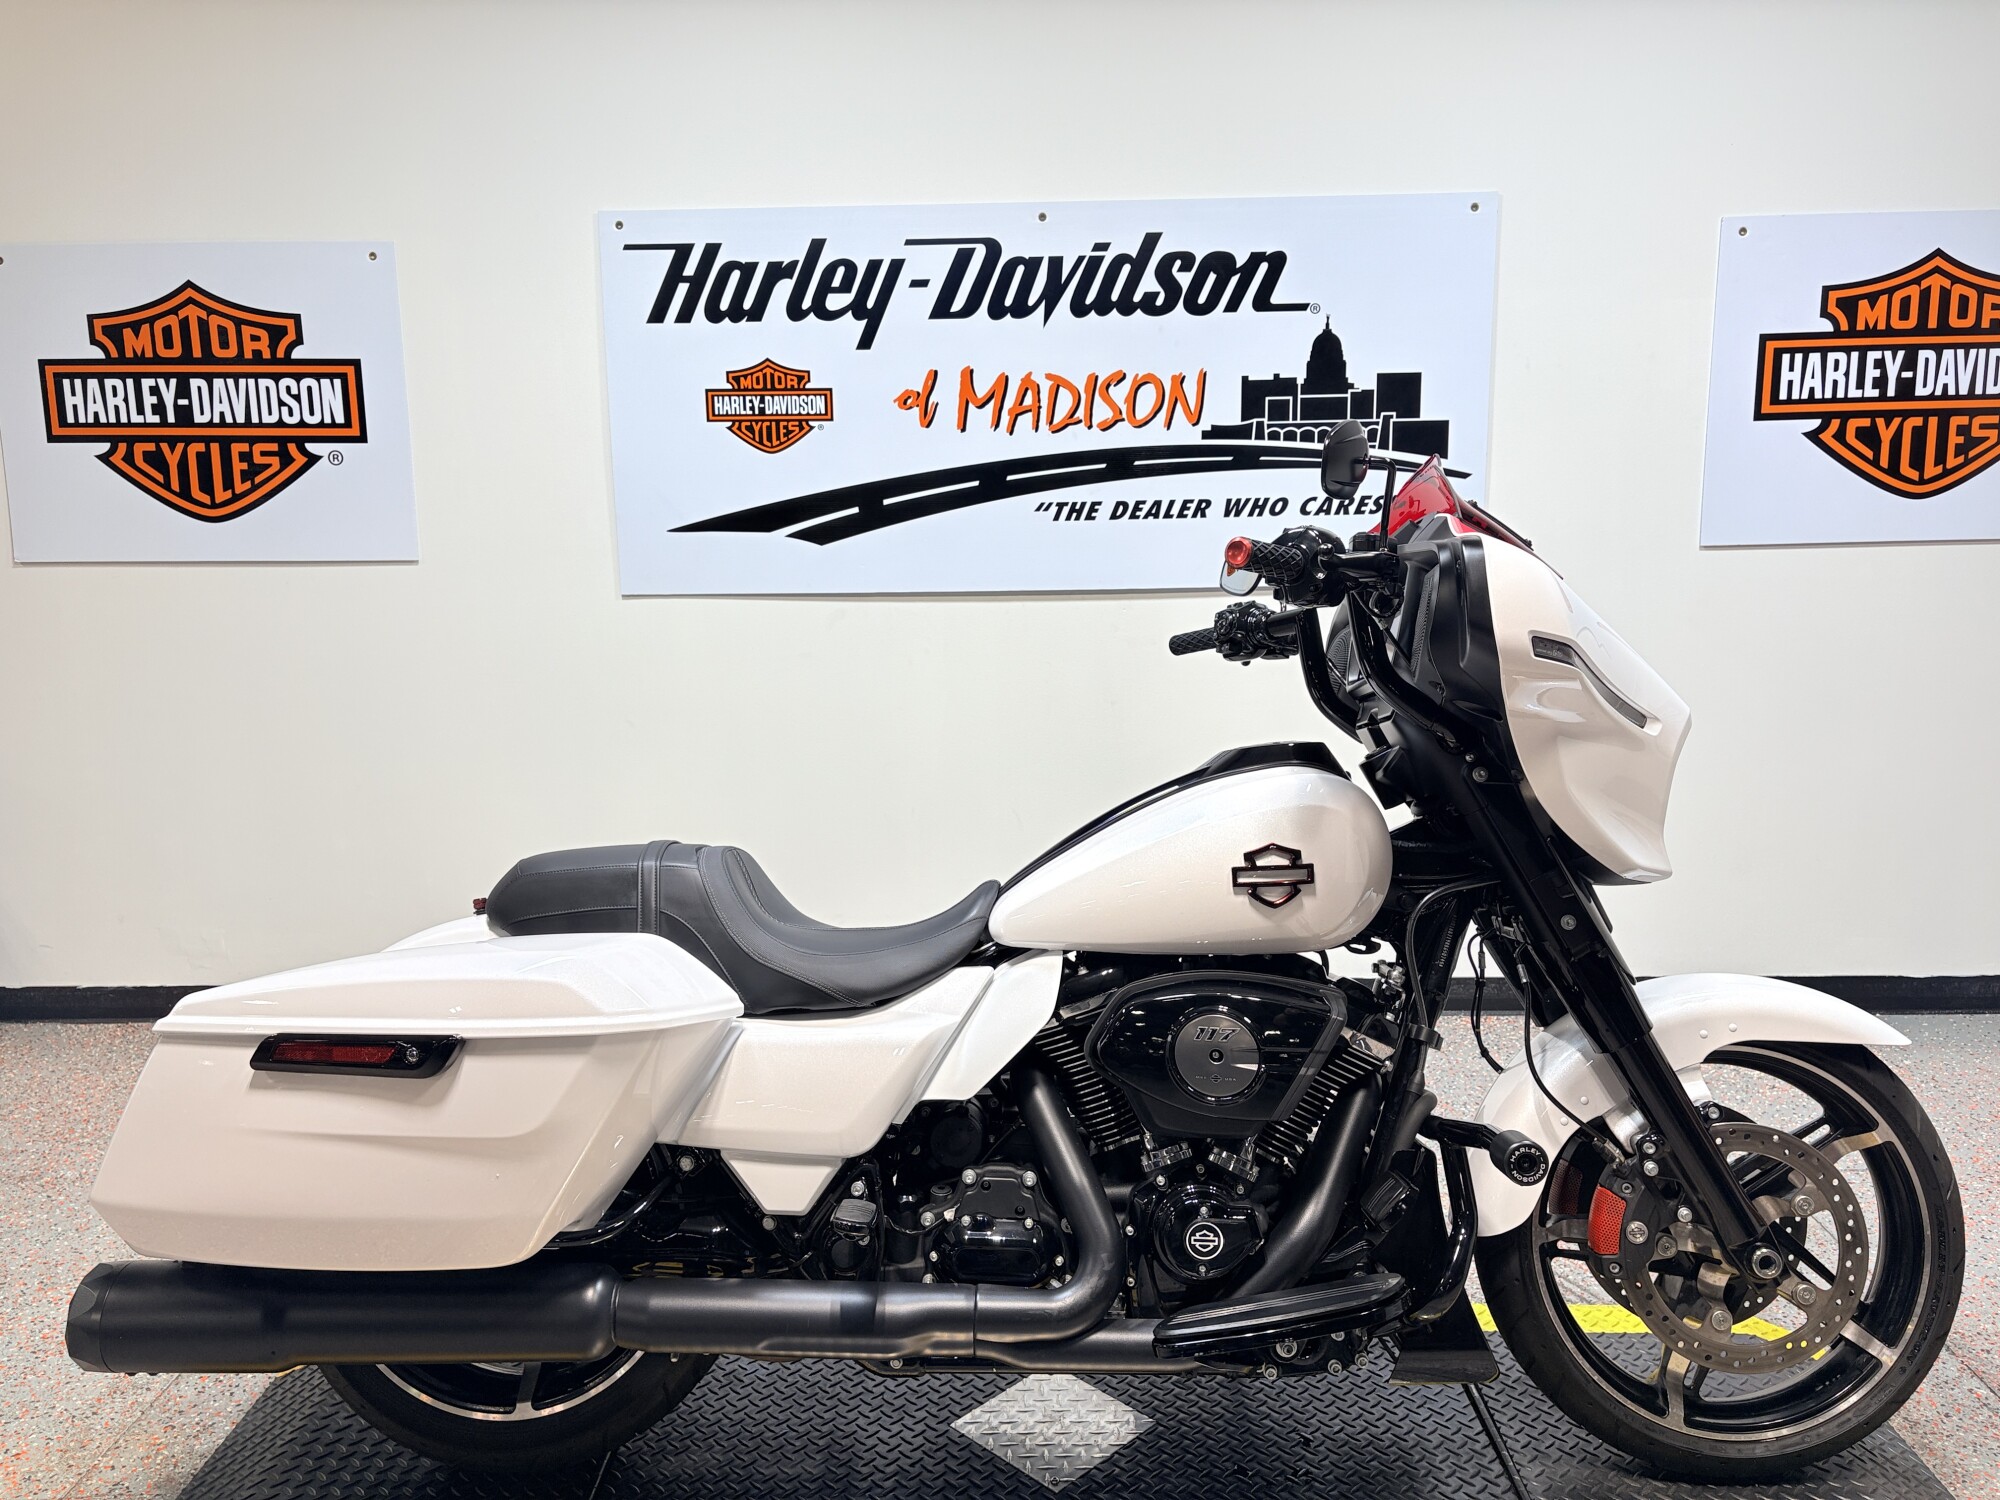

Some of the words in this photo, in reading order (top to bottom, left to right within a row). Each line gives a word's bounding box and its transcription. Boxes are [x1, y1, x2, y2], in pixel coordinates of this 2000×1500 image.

[623, 231, 1311, 350] Harley-Davidson
[122, 303, 271, 359] MOTOR
[62, 377, 346, 425] HARLEY-DAVIDSON
[740, 367, 798, 389] MOTOR
[956, 365, 1207, 436] MADISON
[714, 395, 826, 415] HARLEY-DAVIDSON
[741, 421, 800, 448] CYCLES
[1845, 414, 2000, 482] CYCLES
[133, 442, 281, 506] CYCLES
[1109, 499, 1212, 521] DEALER
[1223, 497, 1289, 518] WHO
[1193, 1025, 1241, 1042] 117
